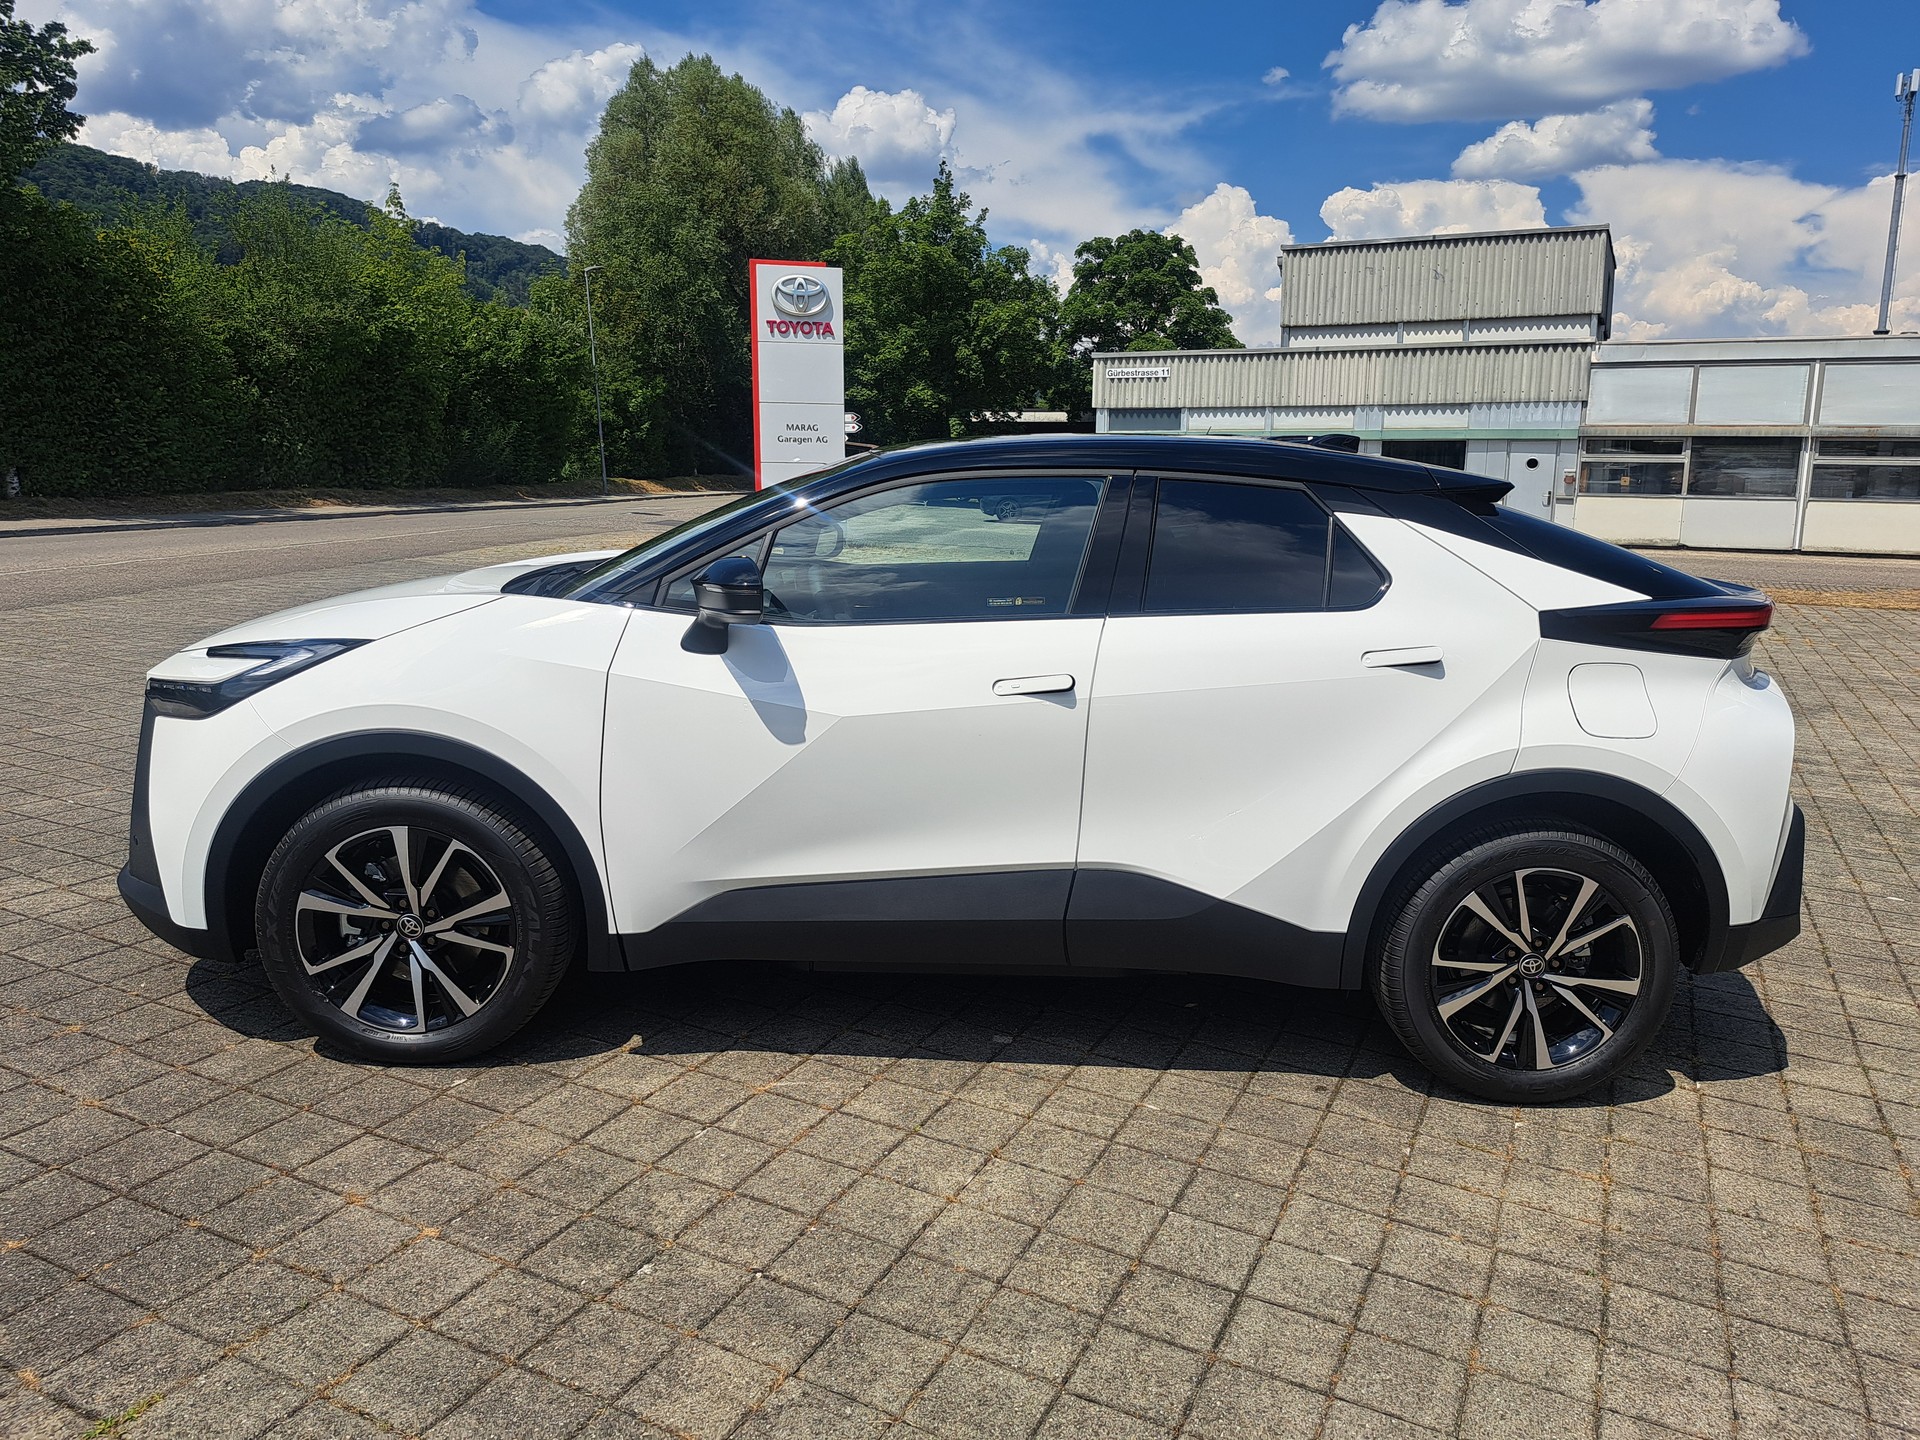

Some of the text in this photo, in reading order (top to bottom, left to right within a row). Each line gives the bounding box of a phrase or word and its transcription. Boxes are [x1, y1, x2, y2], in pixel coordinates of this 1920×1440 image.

[766, 320, 834, 336] TOYOTA
[1107, 368, 1170, 377] Gürbestrasse 11
[786, 423, 819, 432] MARAG
[777, 435, 828, 446] Garagen AG
